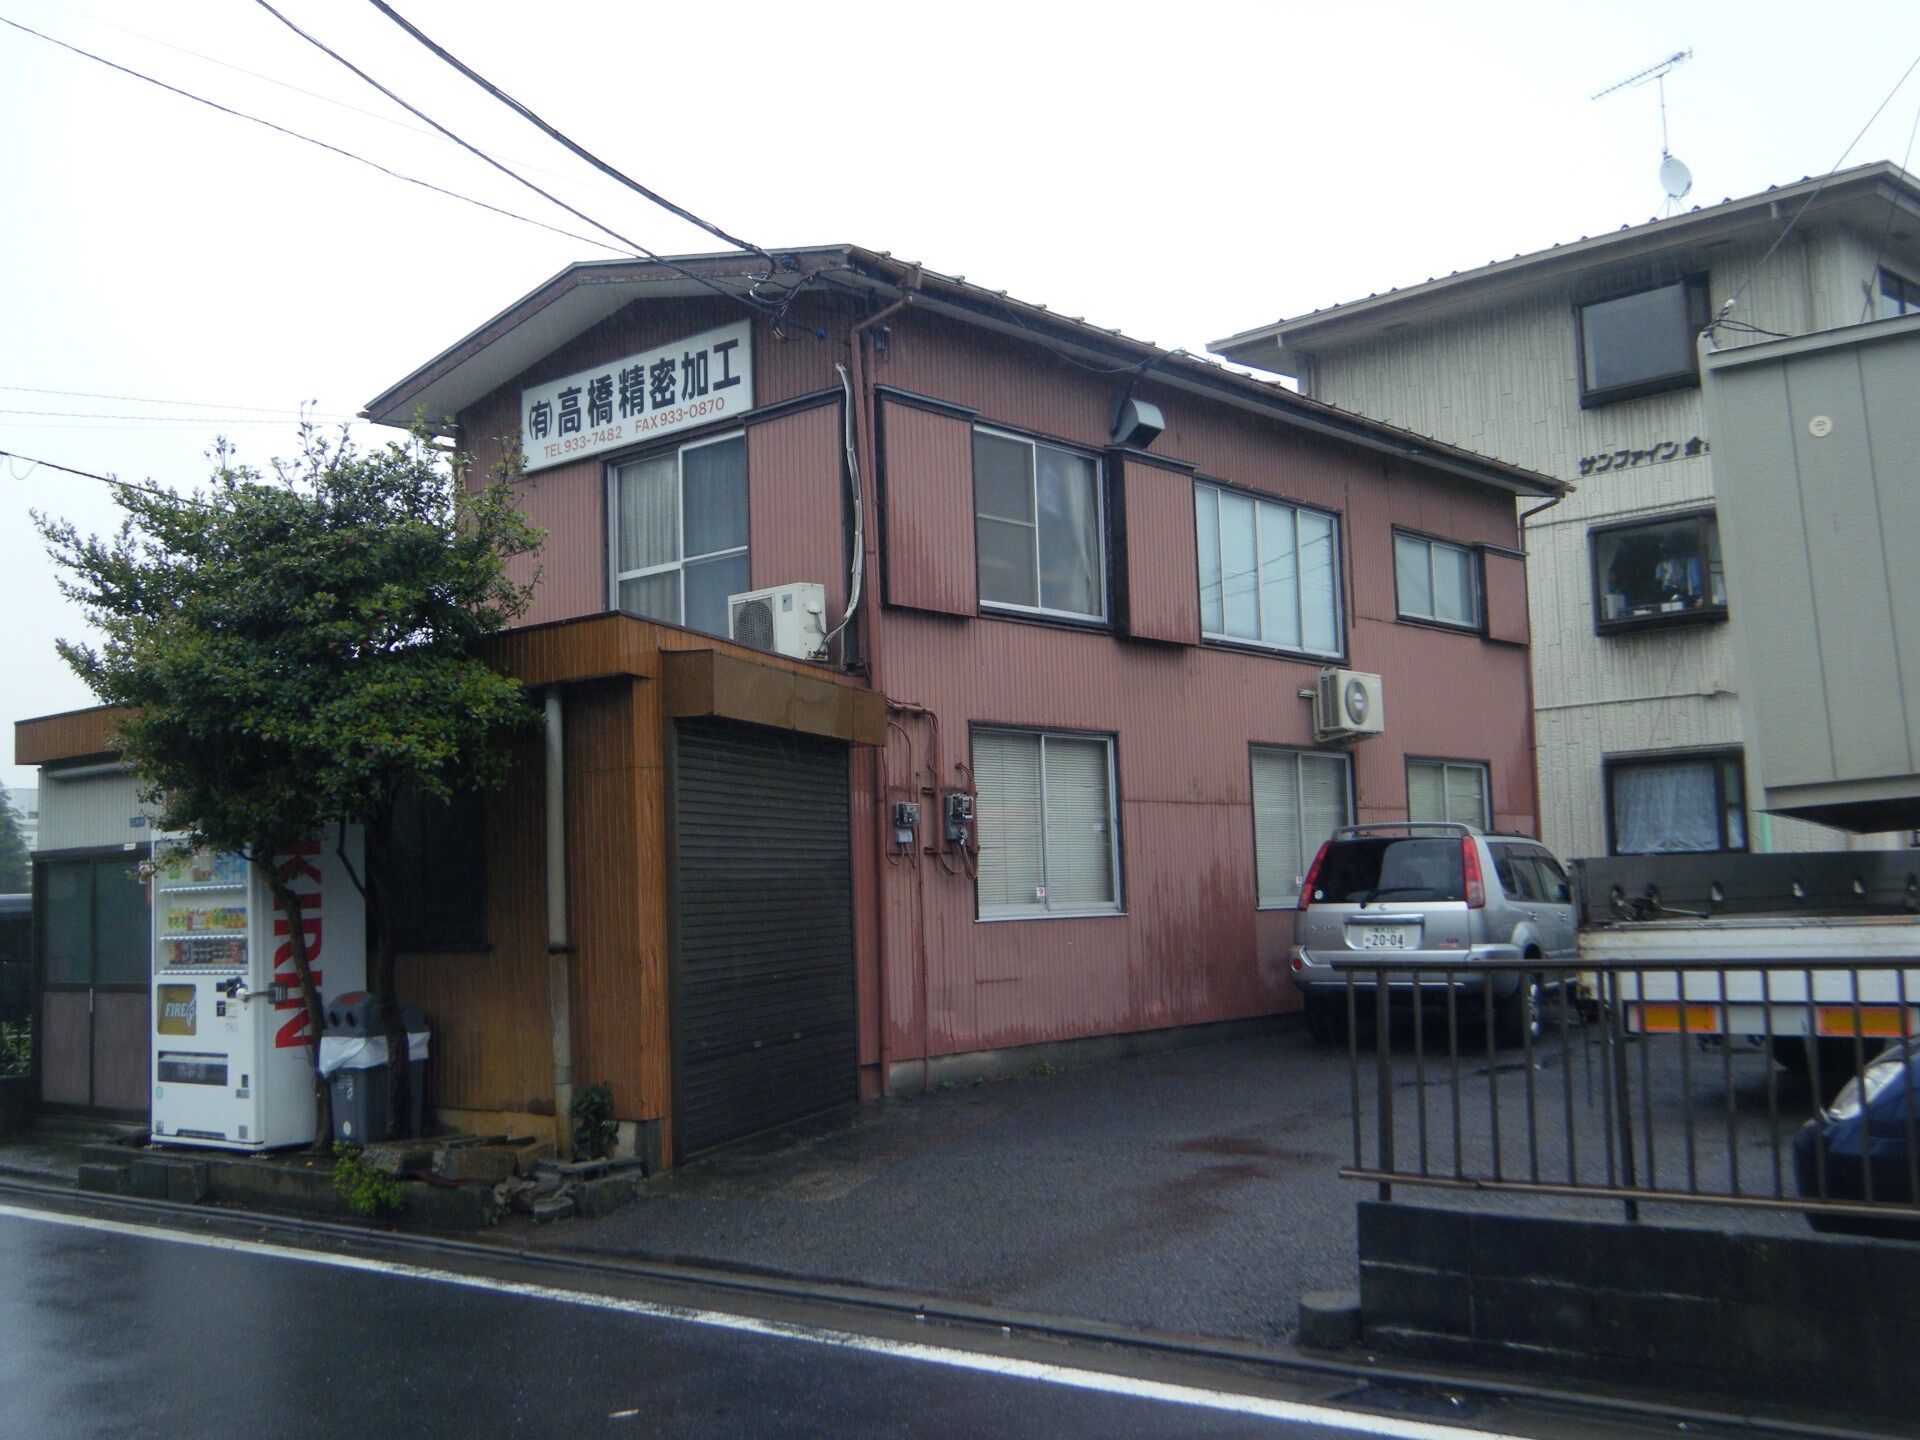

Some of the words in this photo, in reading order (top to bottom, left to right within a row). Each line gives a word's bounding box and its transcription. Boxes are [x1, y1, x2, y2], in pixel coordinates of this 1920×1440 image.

[529, 338, 741, 440] (有)高橋精密加工
[634, 414, 658, 433] FAX
[660, 396, 725, 427] 933-0870
[543, 443, 562, 459] TEL
[564, 425, 622, 453] 933-7482
[165, 1002, 188, 1018] FIRE
